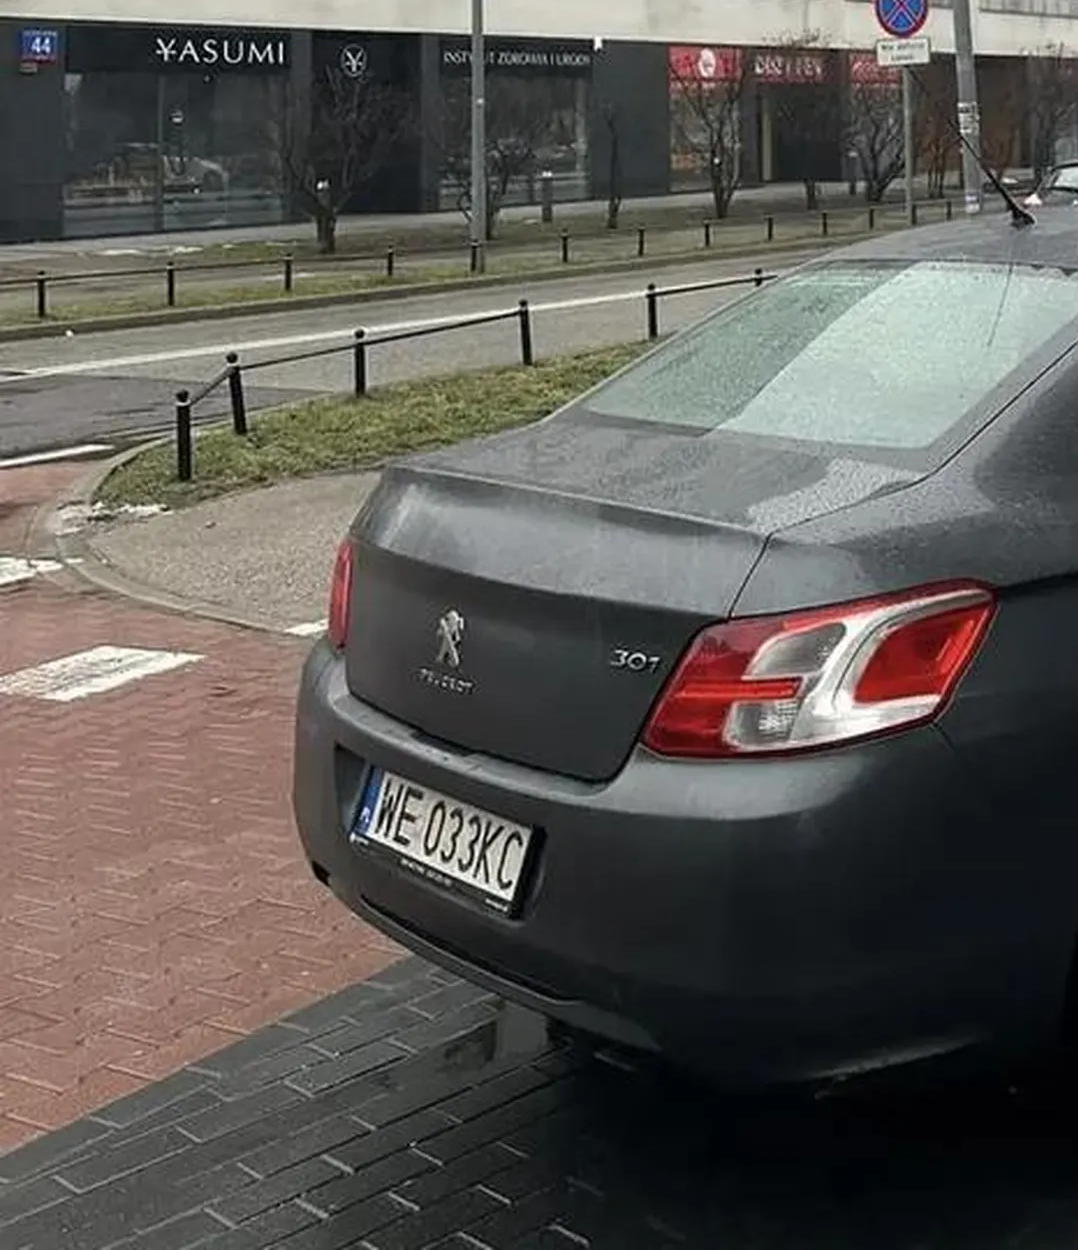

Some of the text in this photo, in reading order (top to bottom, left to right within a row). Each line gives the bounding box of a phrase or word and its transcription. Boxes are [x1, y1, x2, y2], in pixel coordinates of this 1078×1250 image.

[31, 37, 51, 54] 44
[156, 38, 285, 64] YASUMI
[374, 778, 523, 890] WE 033KC
